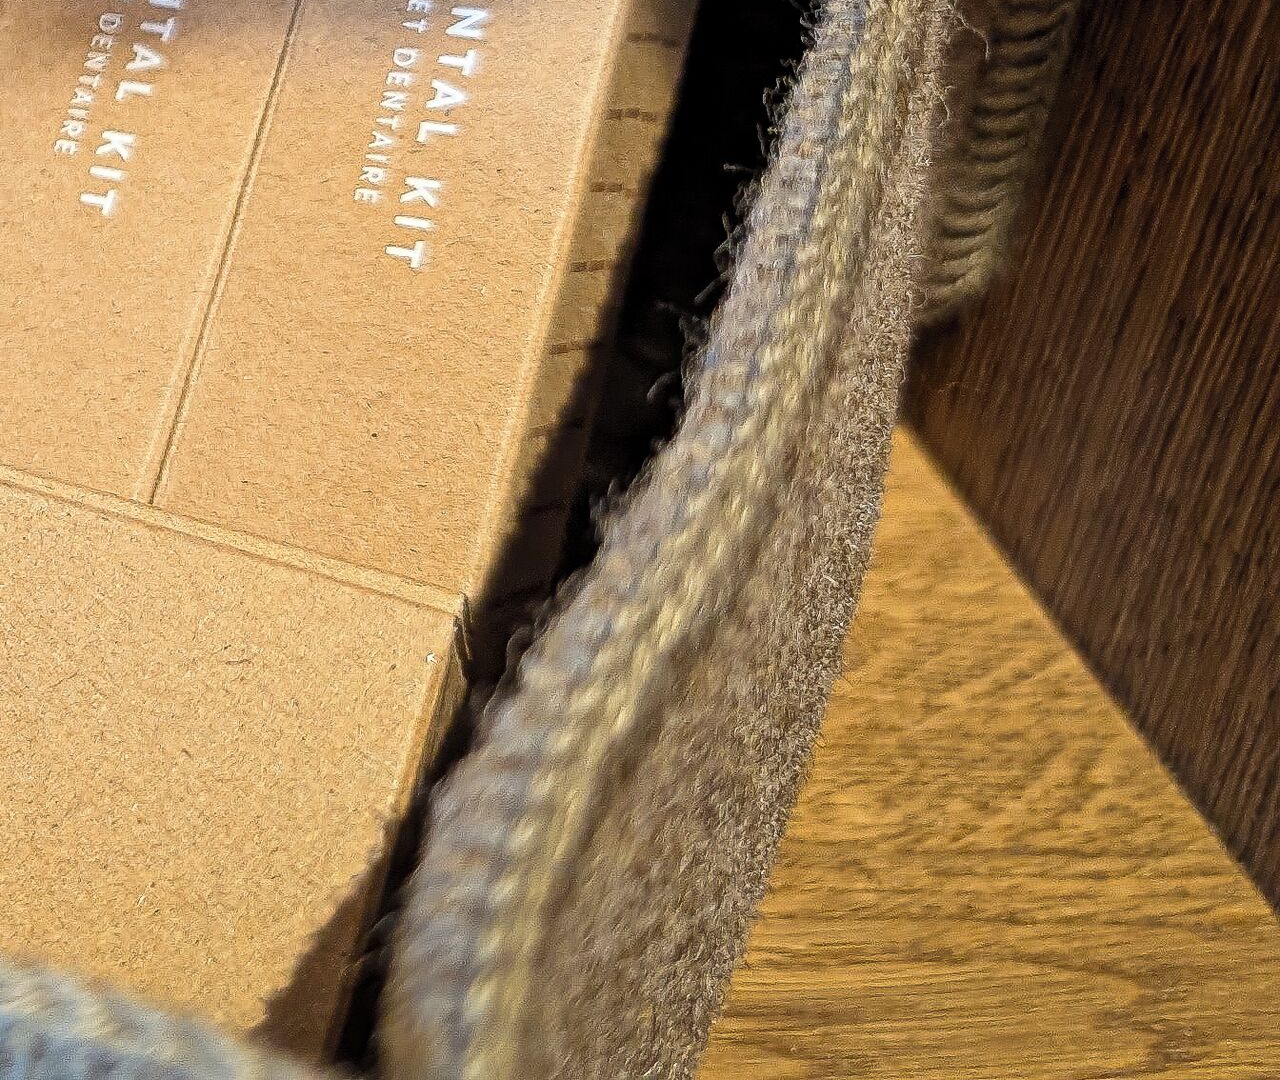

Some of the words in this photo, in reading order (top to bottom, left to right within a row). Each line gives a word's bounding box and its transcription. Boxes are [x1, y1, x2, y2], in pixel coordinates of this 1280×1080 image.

[53, 12, 123, 157] DENTAIRE
[353, 47, 419, 205] DENTAIRE
[80, 128, 135, 218] KIT
[384, 176, 444, 270] KIT
